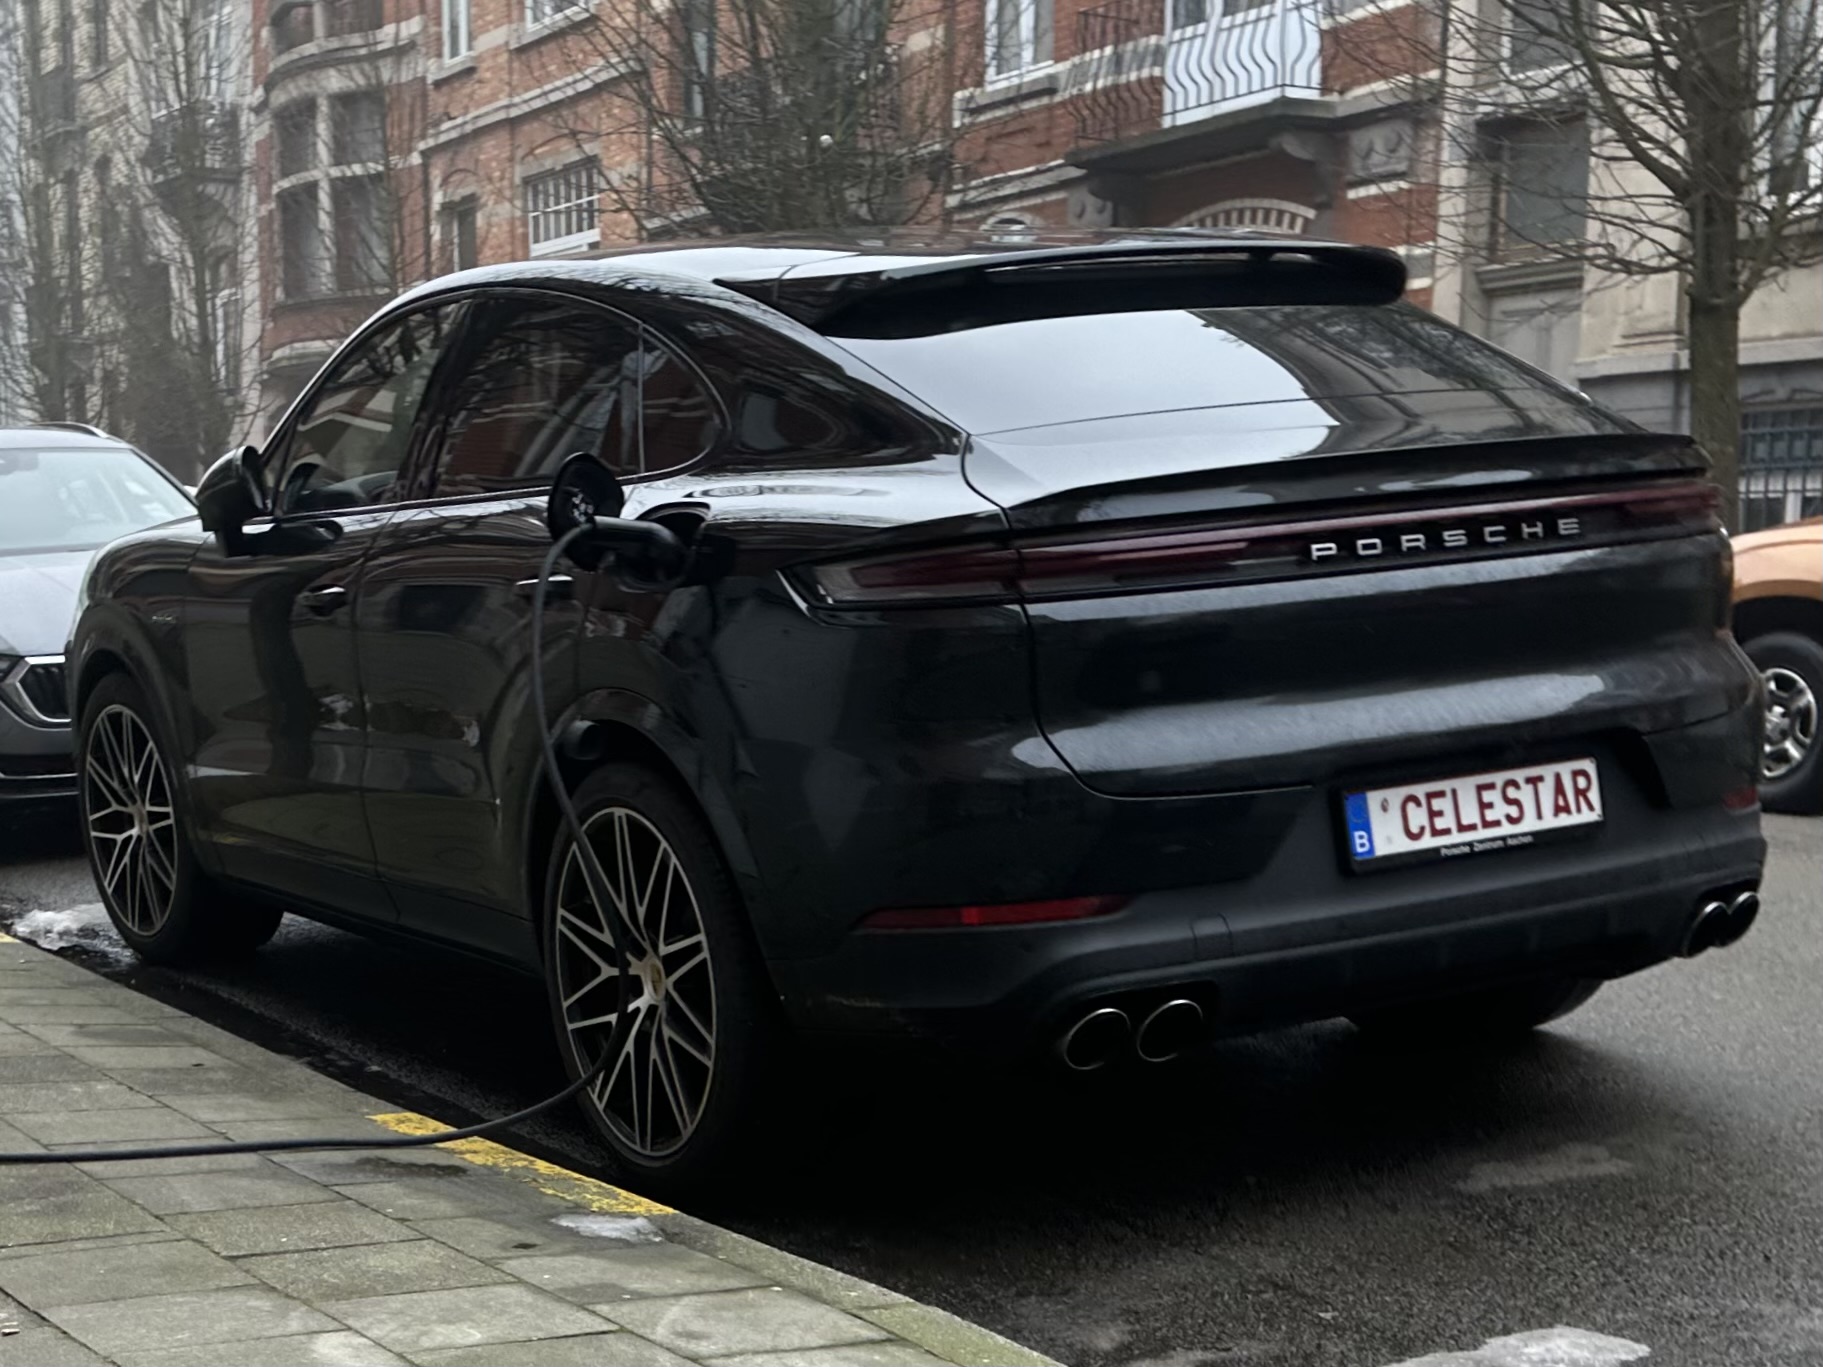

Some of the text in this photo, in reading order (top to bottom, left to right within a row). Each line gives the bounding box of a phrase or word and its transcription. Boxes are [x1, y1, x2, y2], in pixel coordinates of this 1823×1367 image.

[1310, 518, 1580, 560] PORSCHE
[1401, 769, 1595, 842] CELESTAR
[1353, 831, 1370, 853] B
